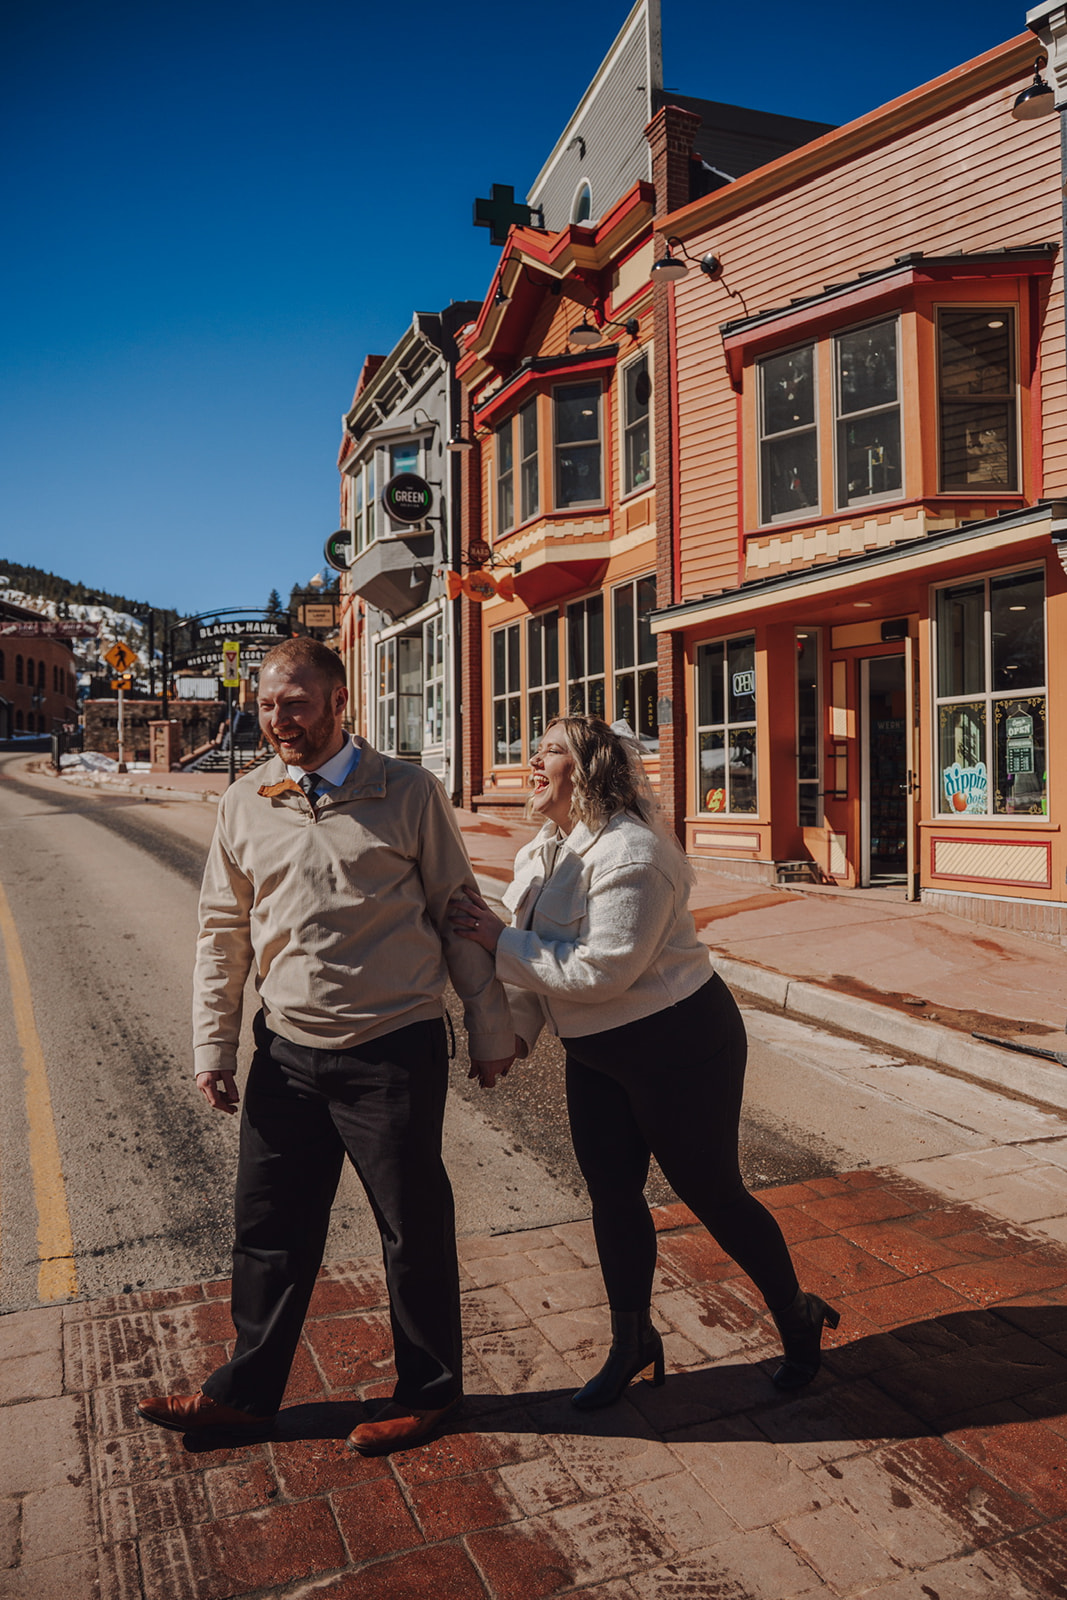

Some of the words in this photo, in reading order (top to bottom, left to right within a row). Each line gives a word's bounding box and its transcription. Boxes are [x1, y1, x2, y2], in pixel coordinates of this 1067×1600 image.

[395, 490, 424, 503] GREEN
[200, 623, 234, 639] BLACK
[246, 622, 278, 634] HAWK
[735, 673, 753, 692] OPEN
[1008, 724, 1031, 736] OPEN
